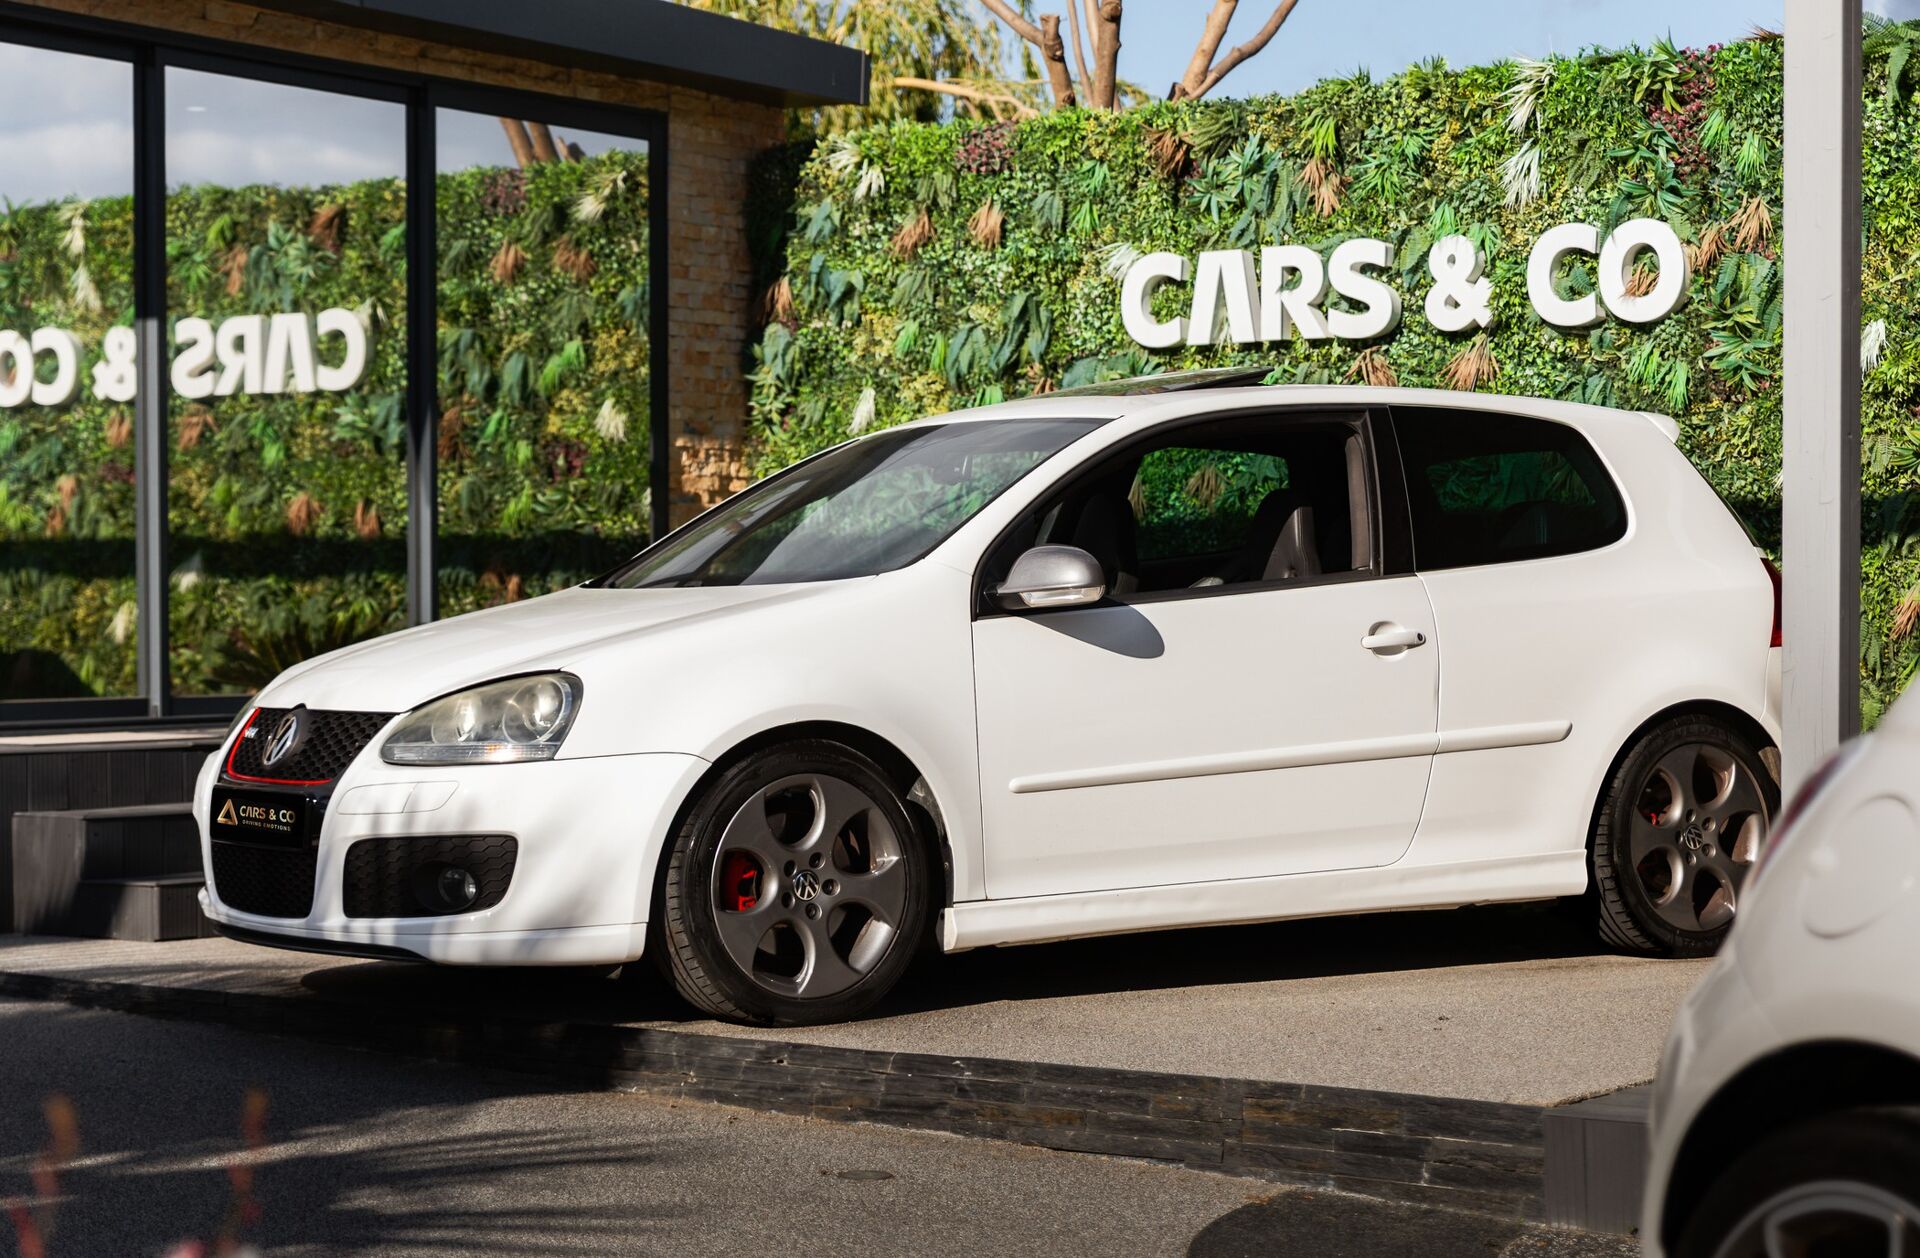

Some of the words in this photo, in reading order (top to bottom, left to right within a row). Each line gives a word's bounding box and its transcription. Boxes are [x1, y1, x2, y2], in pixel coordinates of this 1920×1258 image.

[1120, 238, 1402, 348] CARS
[1424, 234, 1494, 331] &
[1527, 218, 1688, 326] CO
[240, 805, 266, 820] CARS
[268, 808, 277, 821] &
[279, 809, 296, 824] CO
[242, 819, 262, 827] DRIVING
[263, 822, 292, 832] EMOTIONS
